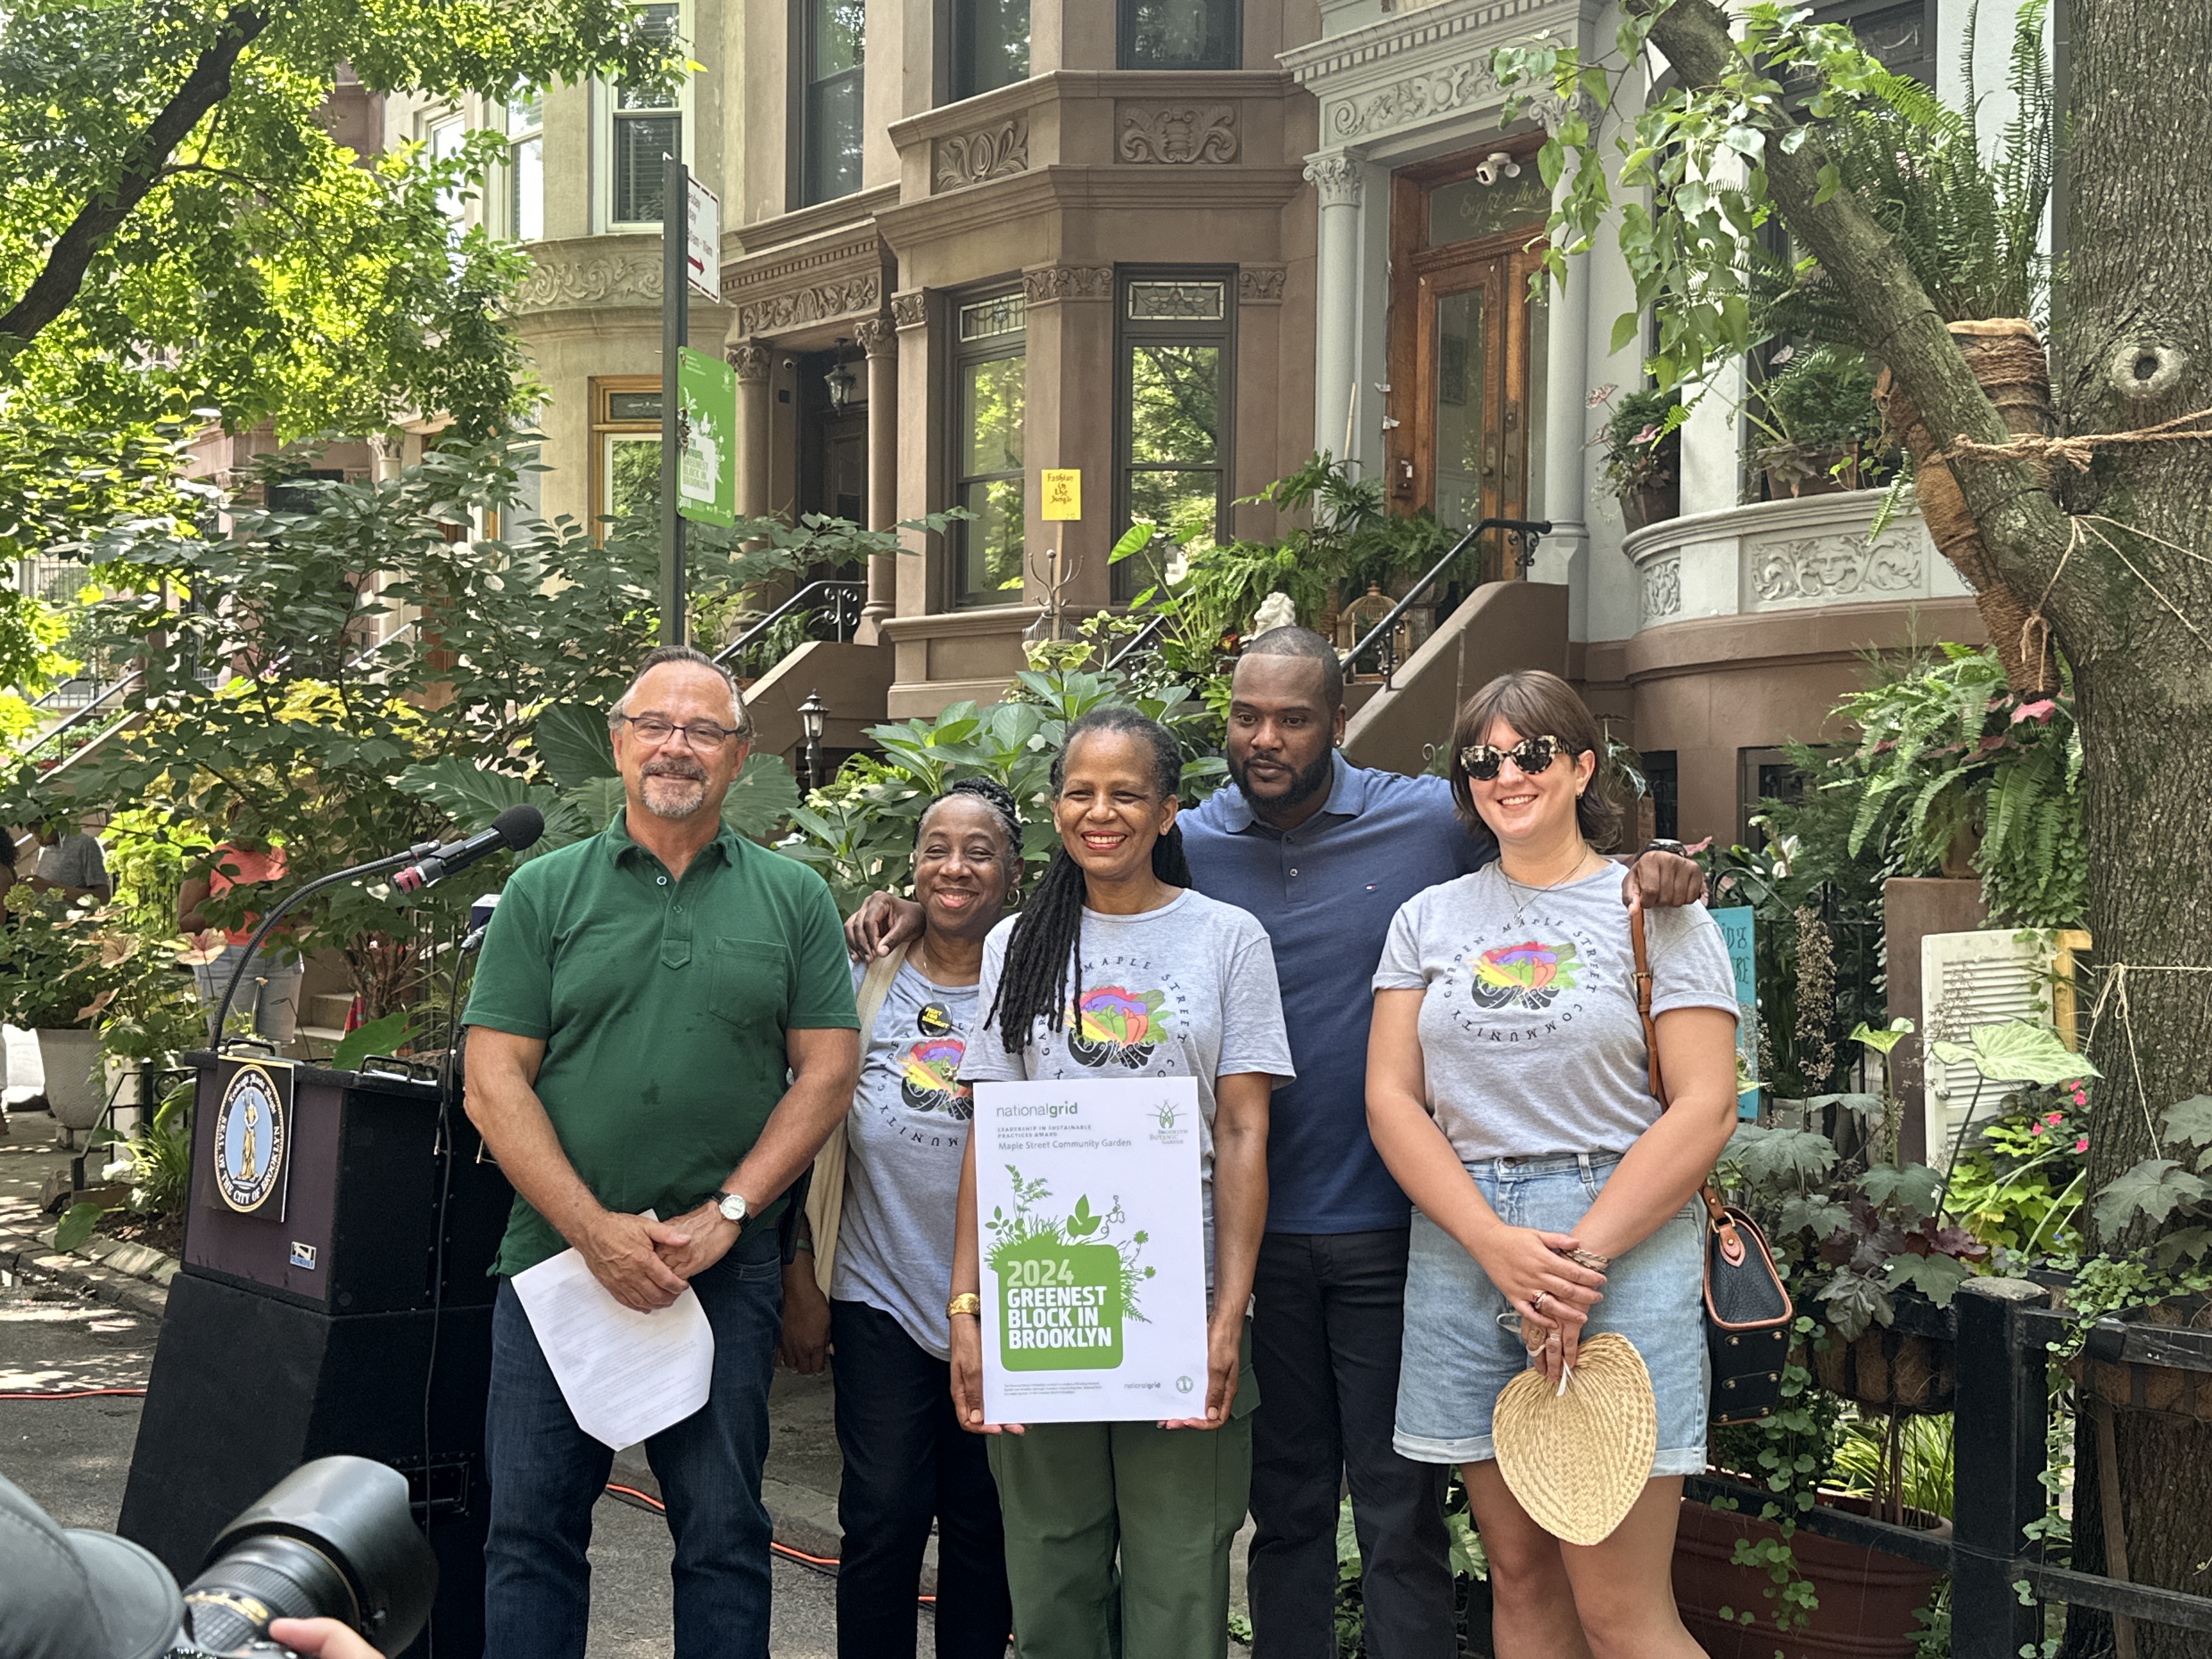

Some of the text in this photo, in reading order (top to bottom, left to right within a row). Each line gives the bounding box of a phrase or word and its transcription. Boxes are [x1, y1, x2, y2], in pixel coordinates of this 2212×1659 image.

[1443, 935, 1486, 998] GARDEN
[1573, 931, 1600, 993] STREET
[1084, 957, 1152, 973] MAPLE
[1161, 974, 1189, 1043] STREET
[1451, 1003, 1583, 1042] COMMUNITY
[879, 1104, 959, 1147] MUNITY
[996, 1101, 1078, 1118] nationalgrid
[998, 1138, 1132, 1152] Maple Street Community Garden
[222, 1170, 235, 1196] THE
[233, 1190, 250, 1205] CITY
[251, 1187, 261, 1201] OF
[262, 1126, 280, 1190] BROOKLYN
[1007, 1259, 1074, 1287] 2024
[1007, 1286, 1107, 1308] GREENEST
[1008, 1307, 1098, 1328] BLOCK IN
[1008, 1327, 1112, 1349] BROOKLYN
